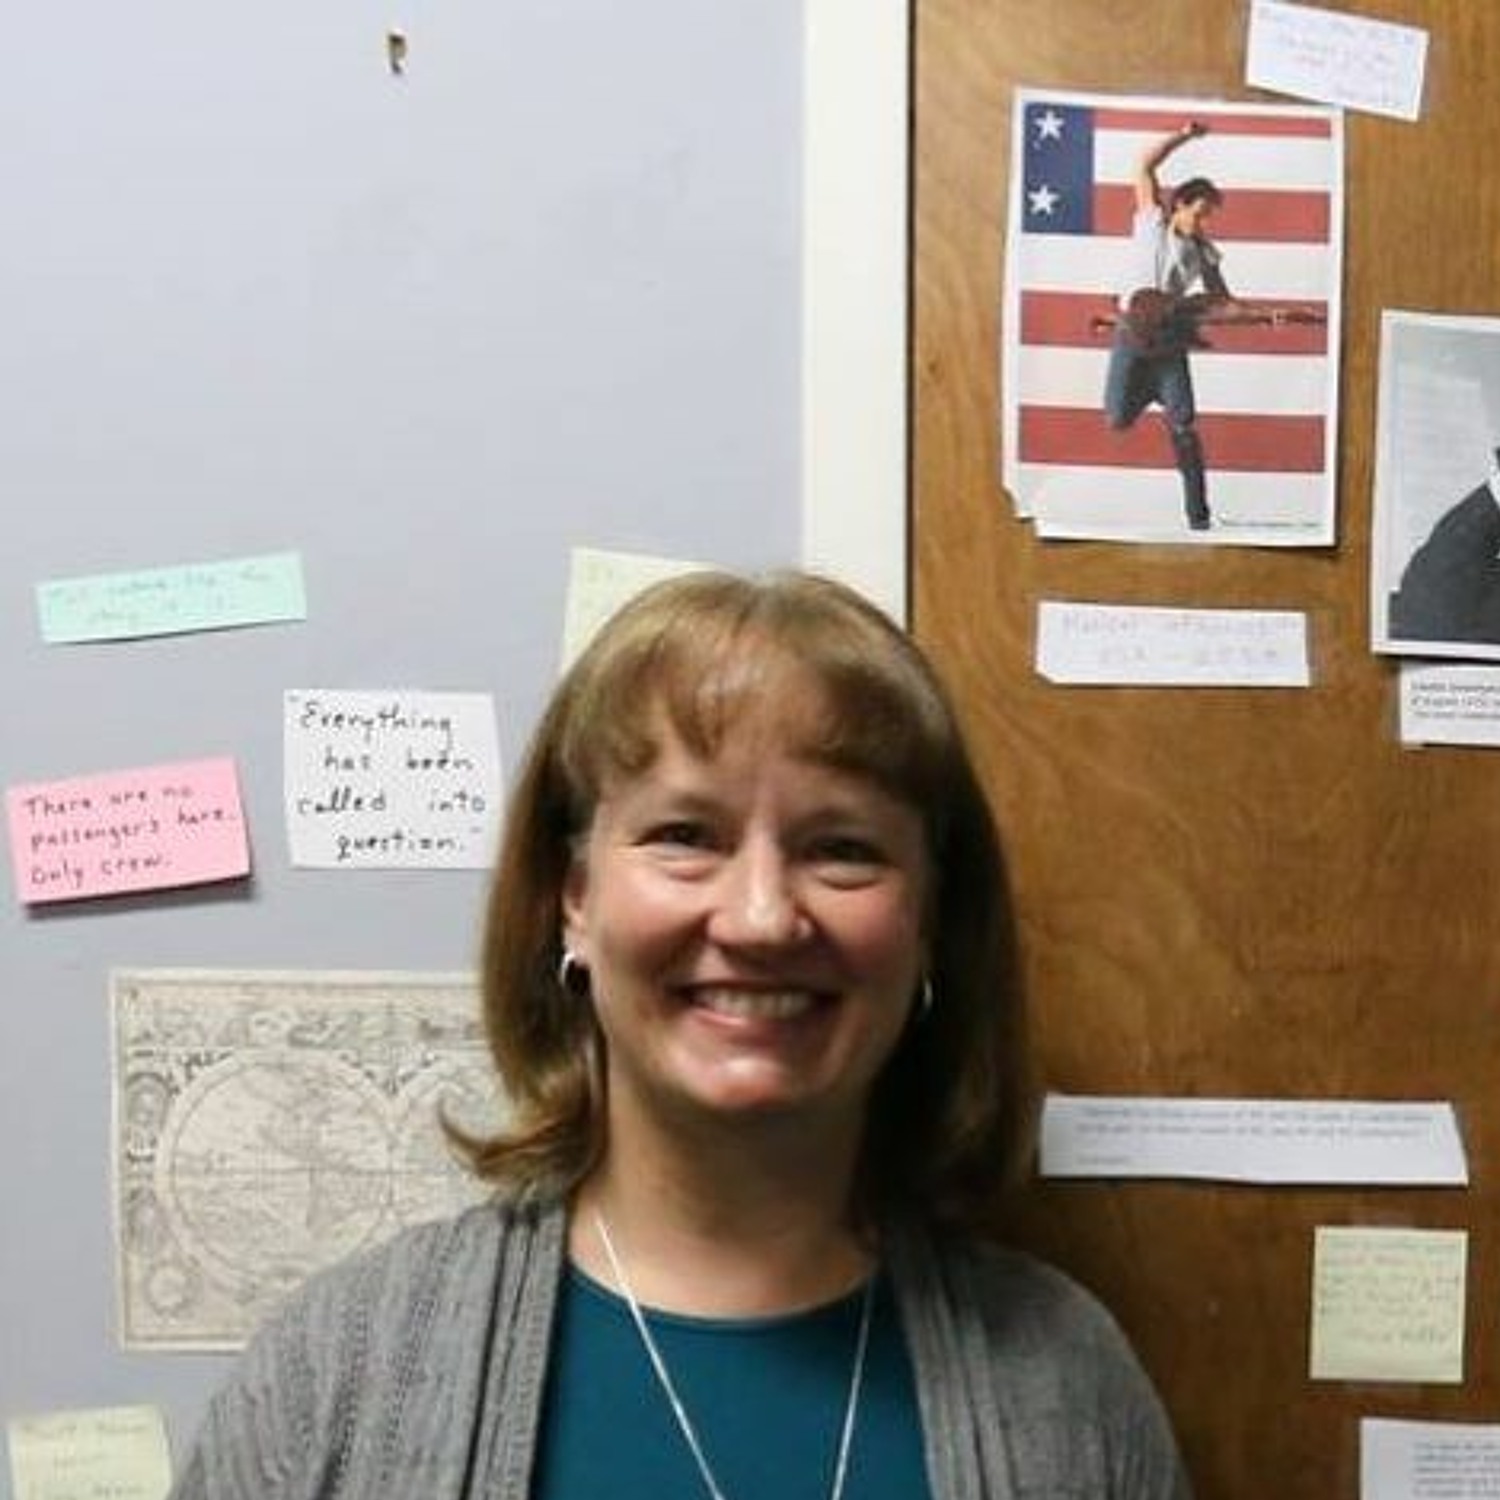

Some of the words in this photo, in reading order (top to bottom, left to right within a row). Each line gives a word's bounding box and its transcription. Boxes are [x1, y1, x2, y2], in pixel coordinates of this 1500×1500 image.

[323, 744, 373, 772] has
[404, 745, 474, 772] been
[22, 793, 92, 819] There
[109, 788, 148, 806] are
[161, 784, 194, 800] no
[296, 784, 388, 815] called
[427, 786, 487, 815] into
[30, 815, 162, 855] passengers
[176, 805, 236, 827] here.
[31, 858, 85, 889] Only
[100, 851, 173, 876] crew.
